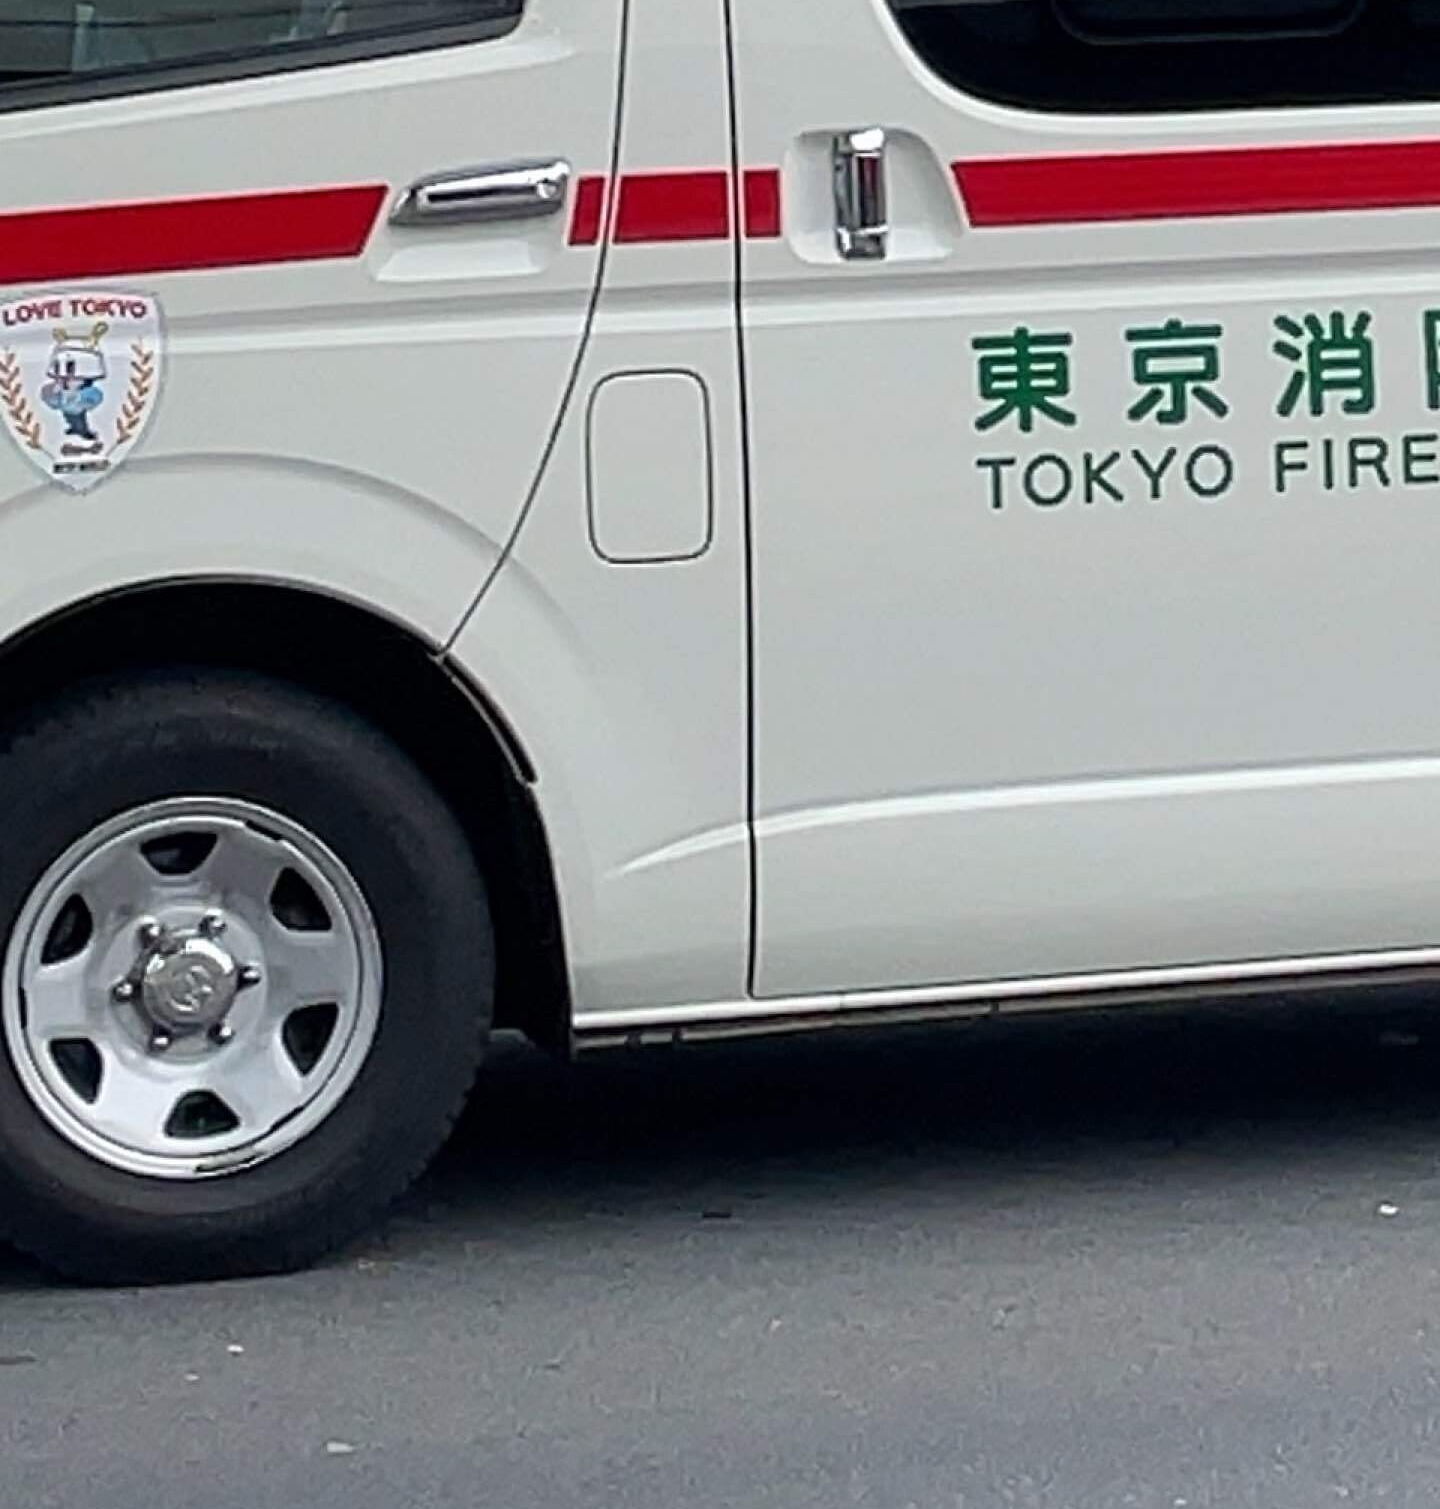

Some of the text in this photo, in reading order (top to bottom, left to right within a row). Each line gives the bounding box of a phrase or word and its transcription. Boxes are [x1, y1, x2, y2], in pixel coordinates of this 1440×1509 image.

[2, 298, 147, 327] LOVE TOKYO
[975, 444, 1234, 509] TOKYO
[1274, 433, 1440, 493] FIRE
